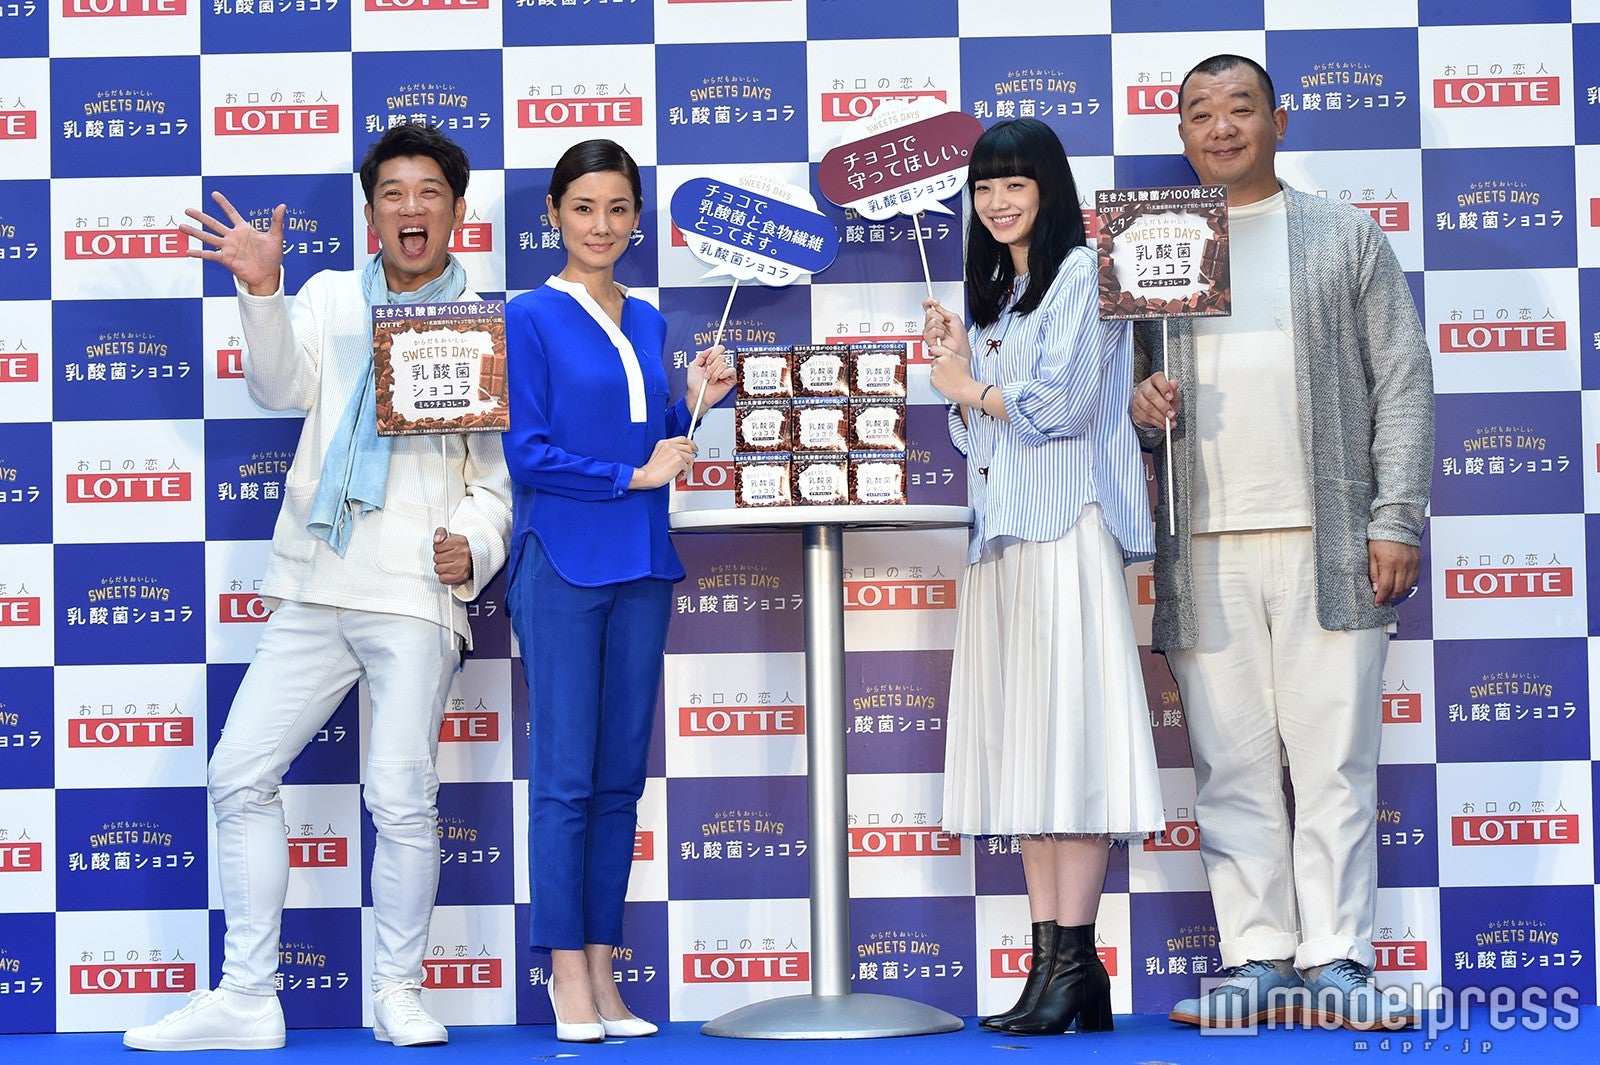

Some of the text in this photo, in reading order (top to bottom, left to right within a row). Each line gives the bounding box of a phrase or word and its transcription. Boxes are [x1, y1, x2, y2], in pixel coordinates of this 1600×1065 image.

[1443, 62, 1548, 76] お口の恋人
[832, 76, 936, 90] お口の恋人
[994, 78, 1077, 95] SWEETS DAYS
[1300, 71, 1384, 88] SWEETS DAYS
[225, 90, 328, 104] お口の恋人
[528, 83, 631, 97] お口の恋人
[690, 85, 772, 102] SWEETS DAYS
[1444, 82, 1548, 104] LOTTE
[84, 99, 166, 116] SWEETS DAYS
[386, 92, 469, 109] SWEETS DAYS
[973, 99, 1101, 119] 乳酸菌ショコラ
[1279, 92, 1407, 112] 乳酸菌ショコラ
[225, 109, 328, 131] LOTTE
[528, 102, 631, 124] LOTTE
[669, 105, 796, 126] 乳酸菌ショコラ
[63, 119, 189, 139] 乳酸菌ショコラ
[866, 116, 898, 134] SWEETS
[900, 111, 920, 122] DAYS
[843, 135, 917, 172] チョコで
[847, 145, 969, 191] 守ってほしい。
[738, 177, 772, 194] SWEETS
[772, 187, 793, 201] DAYS
[868, 174, 957, 213] 乳酸菌ショコラ
[1098, 187, 1224, 203] 生きた乳酸菌が100倍とどく
[705, 184, 768, 214] チョコで
[1457, 190, 1540, 207] SWEETS DAYS
[75, 215, 178, 228] お口の恋人
[288, 217, 318, 232] DAYS
[698, 199, 824, 253] 乳酸菌と食物繊維
[1108, 215, 1133, 235] ビター
[1436, 210, 1564, 231] 乳酸菌ショコラ
[695, 217, 778, 255] とってます。
[837, 224, 950, 244] 酸菌ショコラ
[1125, 227, 1201, 243] SWEETS DAYS
[75, 234, 178, 256] LOTTE
[282, 237, 341, 255] ショコラ
[1135, 243, 1191, 261] 乳酸菌
[699, 242, 789, 279] 乳酸菌ショコラ
[1136, 261, 1191, 277] ショコラ
[375, 303, 501, 319] 生きた乳酸菌が100倍とどく
[1450, 307, 1555, 321] お口の恋人
[836, 320, 918, 334] お口の恋
[746, 329, 776, 344] DAYS
[1450, 326, 1555, 348] LOTTE
[86, 341, 168, 358] SWEETS DAYS
[402, 346, 479, 362] SWEETS DAYS
[65, 362, 191, 382] 乳酸菌ショコラ
[411, 362, 470, 380] 乳酸菌
[413, 381, 470, 397] ショコラ
[1463, 435, 1547, 452] SWEETS DAYS
[77, 458, 180, 472] お口の恋人
[238, 460, 287, 477] SWEETS
[1442, 456, 1570, 476] 乳酸菌ショコラ
[77, 477, 180, 499] LOTTE
[1456, 553, 1561, 567] お口の恋人
[697, 573, 781, 590] SWEETS DAYS
[1456, 572, 1561, 594] LOTTE
[88, 585, 170, 602] SWEETS DAYS
[843, 584, 945, 606] LOTTE
[676, 594, 804, 614] 乳酸菌ショコラ
[67, 606, 193, 626] 乳酸菌ショコラ
[689, 691, 794, 705] お口の恋人
[1469, 682, 1553, 699] SWEETS DAYS
[79, 703, 182, 716] お口の恋人
[853, 693, 936, 710] SWEETS DAYS
[690, 710, 794, 732] LOTTE
[1448, 703, 1577, 723] 乳酸菌ショコラ
[79, 722, 182, 744] LOTTE
[845, 714, 948, 734] 酸菌ショコ
[1462, 800, 1567, 814] お口の恋人
[448, 826, 478, 841] DAYS
[701, 820, 785, 836] SWEETS DAYS
[1462, 820, 1568, 842] LOTTE
[90, 831, 172, 848] SWEETS DAYS
[847, 831, 950, 853] LOTTE
[440, 846, 501, 864] ショコラ
[680, 840, 808, 861] 乳酸菌ショコラ
[69, 851, 196, 872] 乳酸菌ショコラ
[693, 938, 798, 952] お口の恋人
[1165, 935, 1215, 952] SWEETS
[1475, 930, 1560, 947] SWEETS DAYS
[81, 949, 185, 962] お口の恋人
[432, 943, 491, 956] の恋人
[857, 941, 941, 958] SWEETS DAYS
[296, 952, 326, 967] DAYS
[693, 957, 798, 979] LOTTE
[1454, 951, 1583, 971] 乳酸菌ショコラ
[81, 968, 185, 990] LOTTE
[421, 963, 491, 984] TTE
[850, 961, 964, 982] 酸菌ショコラ
[275, 972, 350, 991] 菌ショコラ
